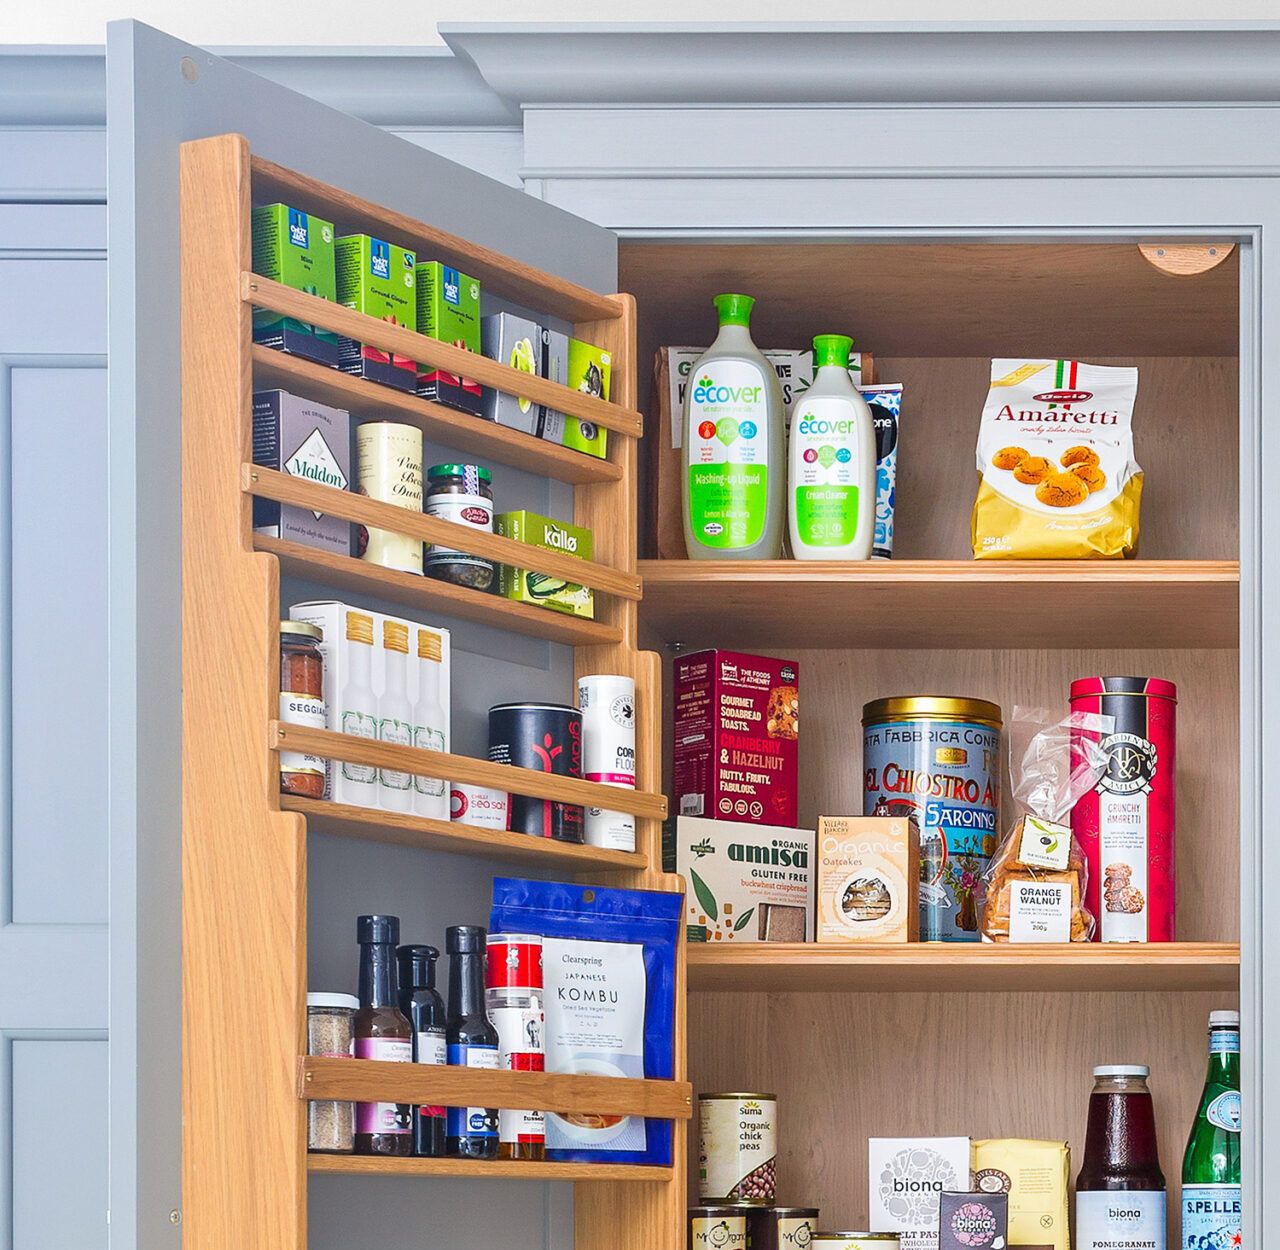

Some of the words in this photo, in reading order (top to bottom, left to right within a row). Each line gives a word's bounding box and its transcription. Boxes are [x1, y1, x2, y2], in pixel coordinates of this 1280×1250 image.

[694, 384, 762, 404] ecover
[311, 411, 333, 426] ORIGINAL
[994, 404, 1119, 425] Amaretti
[800, 418, 855, 435] ecover
[292, 458, 343, 489] Maldon
[752, 669, 771, 679] FOODS
[720, 694, 754, 708] GOURMET
[720, 706, 762, 721] SODABREAD
[720, 717, 750, 732] TOASTS.
[885, 728, 960, 745] FABBRICA
[1108, 733, 1140, 745] ARDEN
[569, 720, 583, 778] gravy
[720, 733, 781, 755] CRANBERRY
[720, 748, 729, 764] &
[732, 750, 785, 771] HAZELNUT
[720, 768, 745, 782] NUTTY.
[745, 771, 771, 785] FRUITY.
[882, 764, 979, 799] CHIOSTRO
[720, 781, 757, 795] FABULOUS.
[1108, 803, 1141, 813] CRUNCHY
[926, 806, 996, 827] SARONNO
[1107, 815, 1141, 824] AMARETTI
[771, 839, 808, 850] ORGANIC
[822, 838, 905, 858] Organic
[727, 843, 808, 869] amisa
[822, 857, 863, 866] Oatcakes
[751, 869, 786, 880] GLUTEN
[788, 872, 808, 882] FREE
[741, 879, 776, 890] buckwheat
[775, 882, 808, 892] crispbread
[1020, 887, 1062, 897] ORANGE
[1020, 896, 1062, 906] WALNUT
[562, 954, 603, 968] Clearspring
[565, 973, 607, 982] JAPANESE
[557, 987, 619, 1004] KOMBU
[739, 1106, 763, 1116] Suma
[739, 1121, 771, 1131] Organic
[739, 1131, 763, 1141] chick
[739, 1142, 761, 1152] peas
[894, 1178, 943, 1192] biona
[1109, 1207, 1142, 1219] biona
[956, 1218, 991, 1229] biona
[1092, 1240, 1157, 1249] POMEGRANATE
